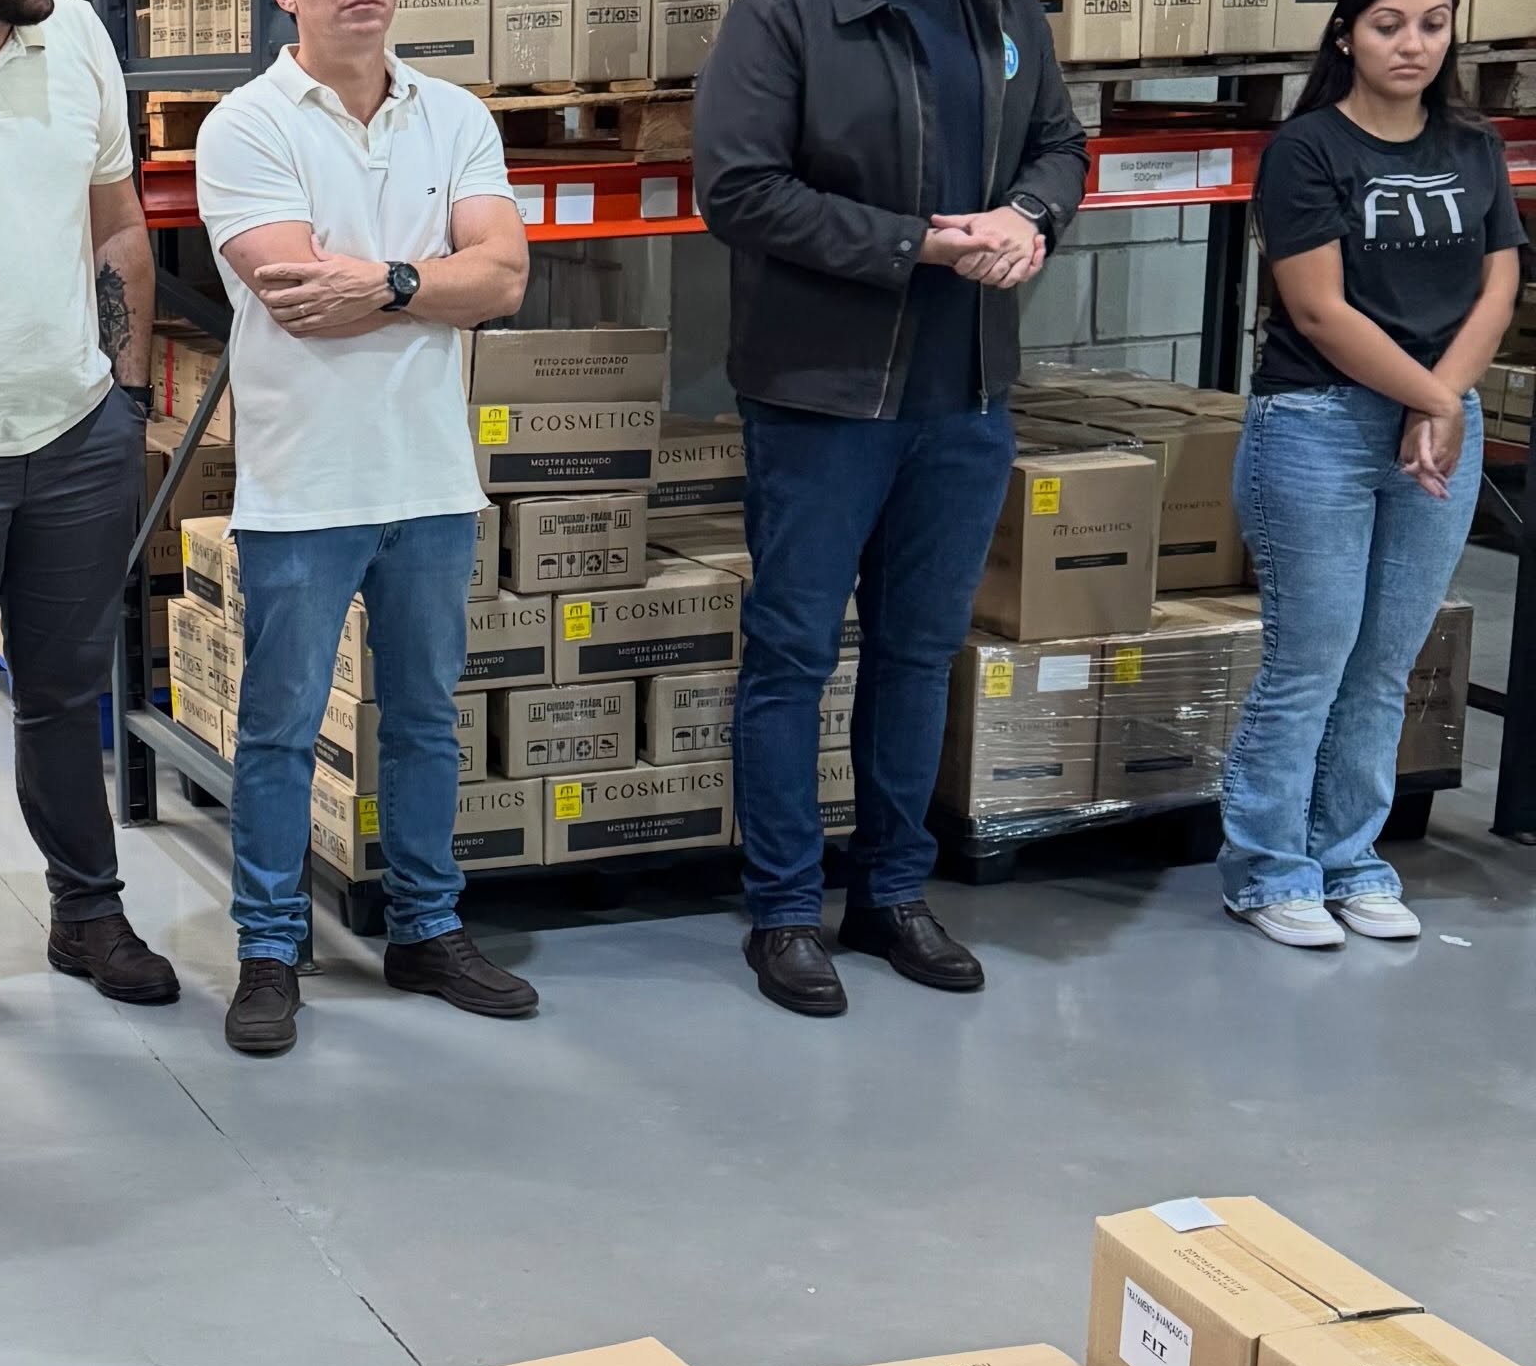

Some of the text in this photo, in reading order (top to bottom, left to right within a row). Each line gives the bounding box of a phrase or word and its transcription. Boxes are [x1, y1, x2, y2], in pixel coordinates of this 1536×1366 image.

[1134, 172, 1162, 182] 500ml
[1364, 180, 1465, 239] FIT
[534, 356, 628, 366] FEITO COM CUIDADO
[535, 367, 625, 377] BELEZA DE VERDADE
[530, 411, 655, 432] COSMETICS
[531, 458, 564, 467] MOSTRE
[579, 457, 611, 465] MUNDO
[548, 467, 595, 475] SUA BELEZA
[1071, 522, 1132, 535] COSMETICS
[615, 594, 734, 621] COSMETICS
[473, 656, 504, 665] MUNDO
[182, 701, 218, 731] COSMETICS
[604, 773, 724, 802] COSMETICS
[1142, 1329, 1167, 1358] FIT
